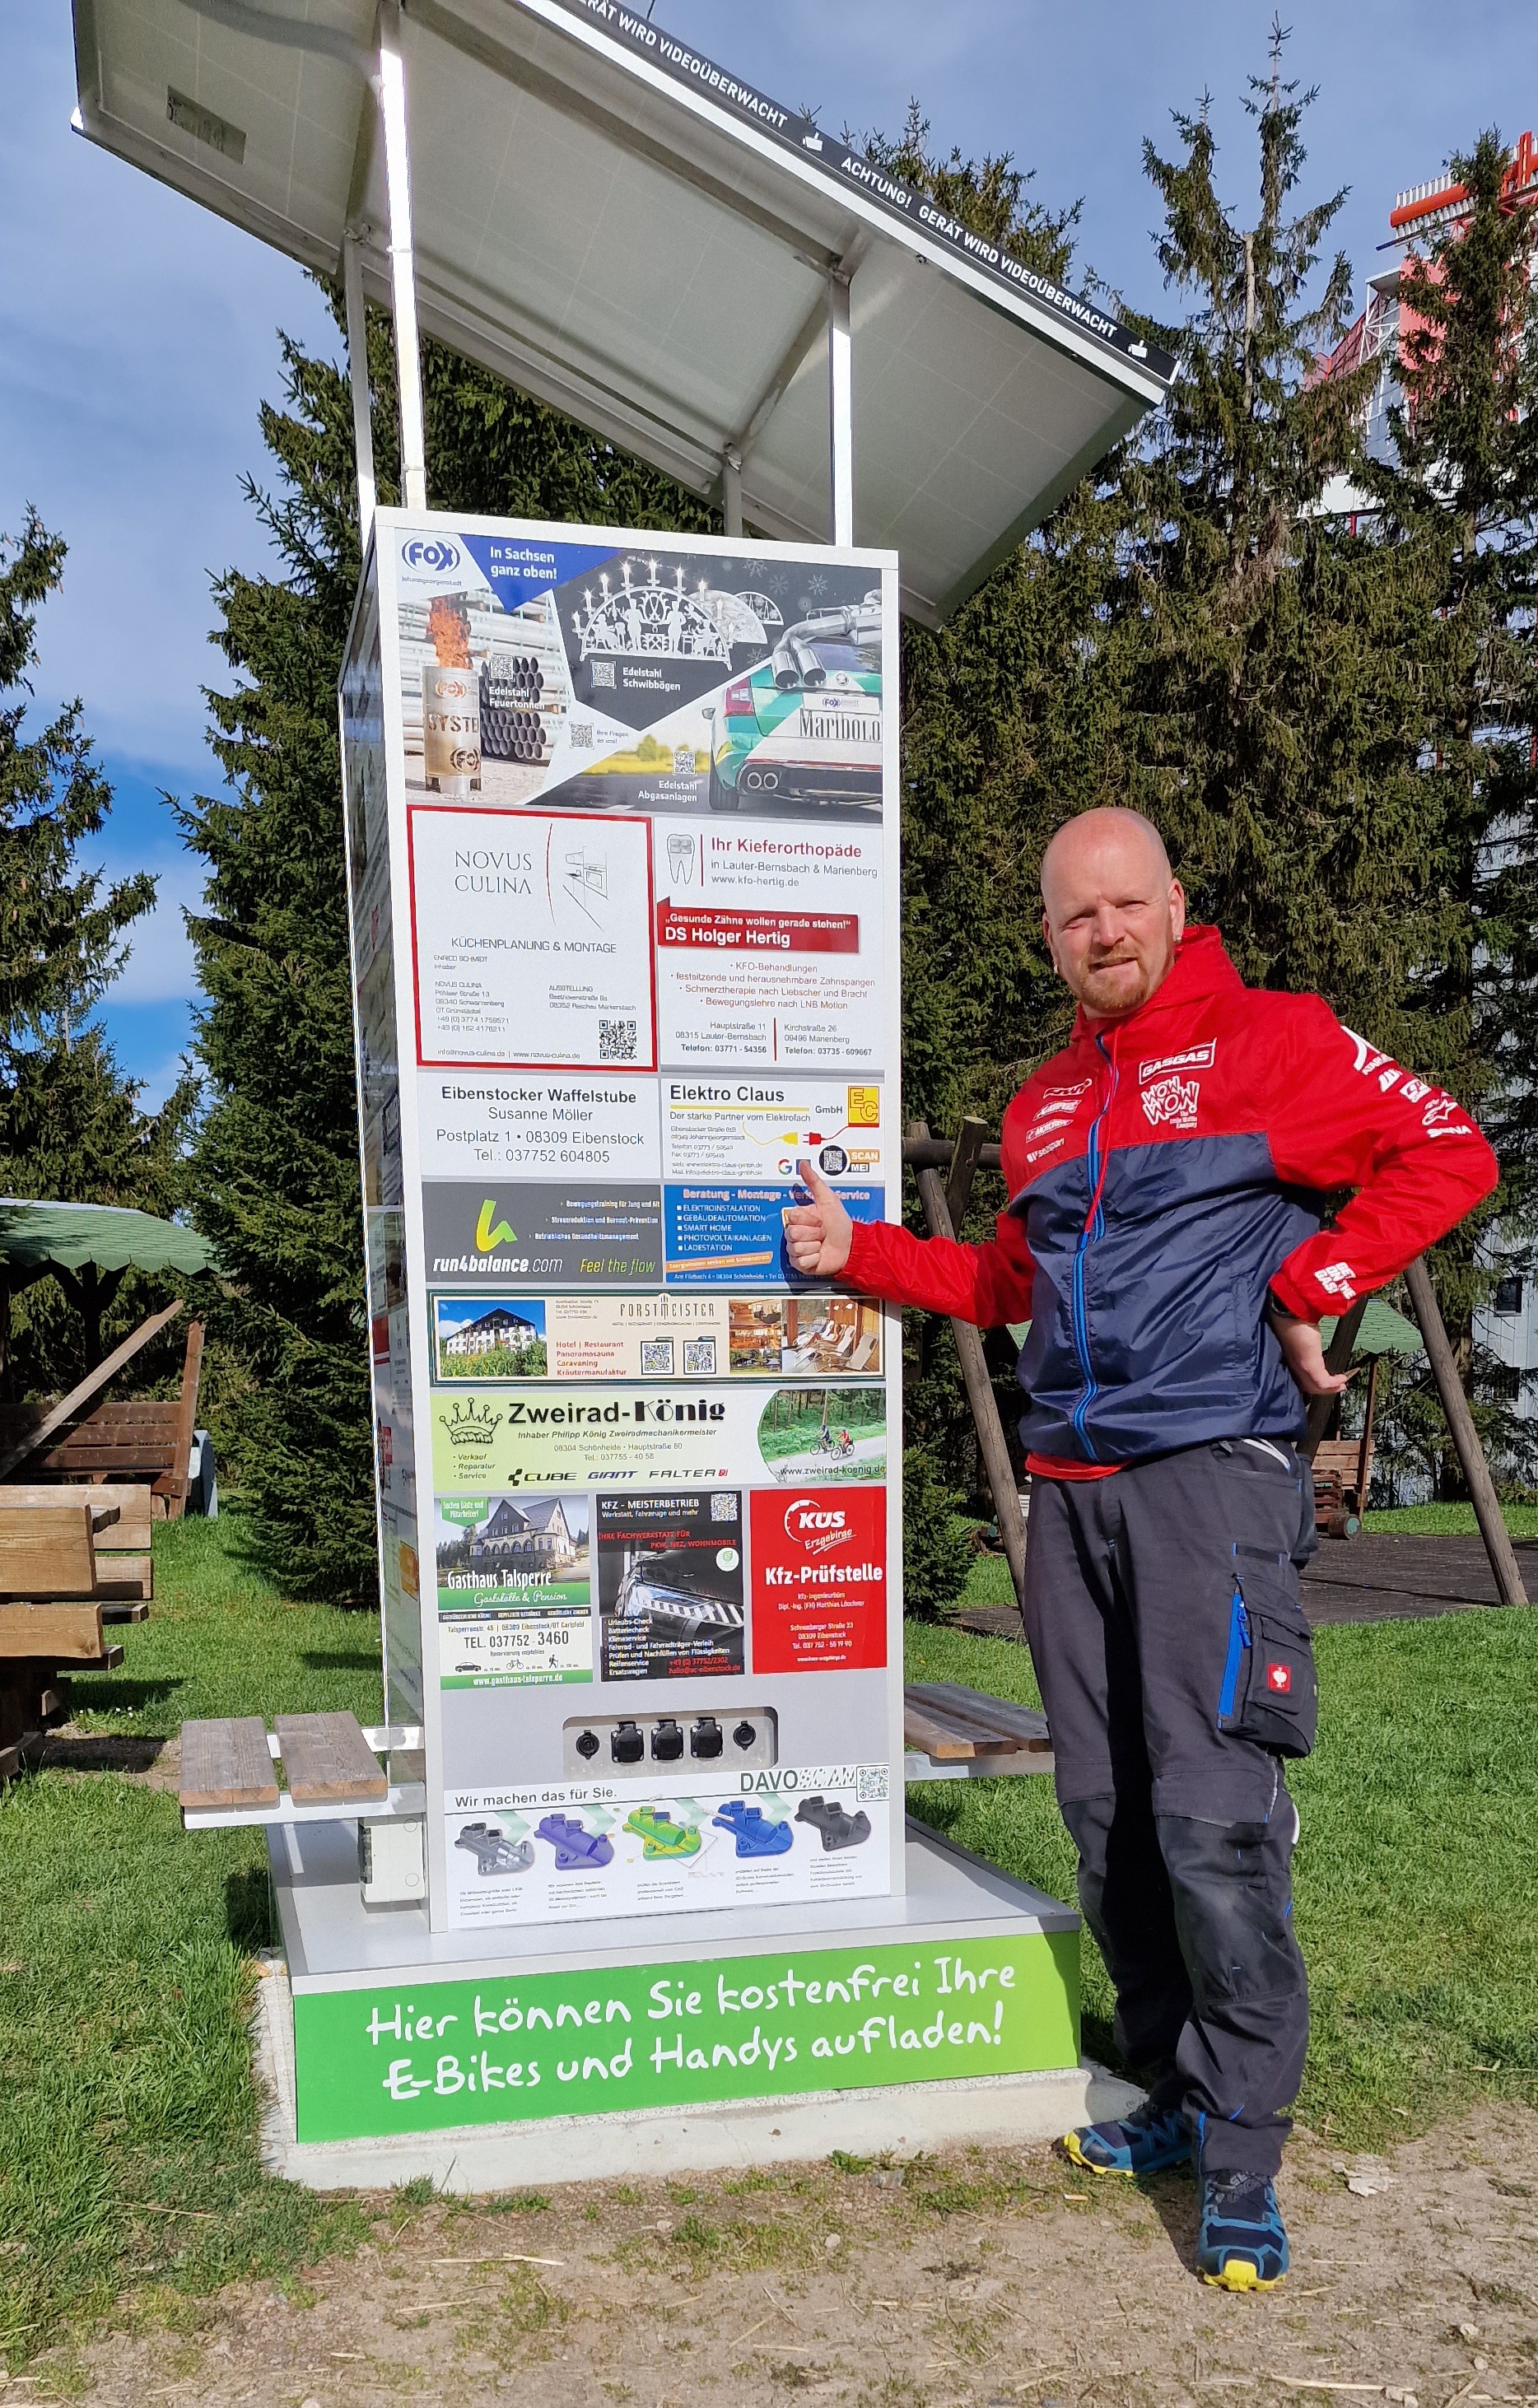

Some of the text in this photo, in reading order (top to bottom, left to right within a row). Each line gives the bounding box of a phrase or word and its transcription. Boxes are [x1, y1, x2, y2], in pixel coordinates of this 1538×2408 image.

[618, 12, 657, 46] WIRD
[659, 36, 788, 128] VIDEOÜBERWACHT
[841, 156, 1117, 339] ACHTUNG! GERÄT WIRD VIDEOÜBERWACHT
[409, 540, 454, 571] FOX
[490, 546, 555, 563] In Sachsen
[491, 566, 557, 580] ganz oben!
[622, 668, 662, 679] Edelstahl
[622, 678, 681, 691] Schwibbögen
[489, 687, 529, 698] Edelstahl
[489, 698, 545, 710] Feuertonnen
[659, 780, 698, 791] Edelstahl
[638, 791, 697, 803] Abgasanlagen
[711, 837, 862, 859] Ihr Kieferorthopäde
[454, 850, 532, 871] NOVUS
[711, 859, 878, 879] in Lauter-Bernsbach & Marienberg
[454, 875, 532, 895] CULINA
[711, 875, 799, 887] www.kfo-hertig.de
[715, 914, 743, 925] Zähne
[745, 917, 776, 927] wollen
[778, 919, 809, 930] gerade
[665, 927, 790, 948] DS Holger Hertig
[451, 936, 617, 953] KÜCHENPLANUNG & MONTAGE
[735, 962, 818, 973] KFO-Behandlungen
[729, 974, 745, 983] und
[748, 975, 818, 985] herausnehmbare
[819, 977, 875, 987] Zahnspangen
[685, 985, 757, 996] Schmerztherapie
[758, 987, 779, 995] nach
[781, 988, 822, 997] Liebscher
[823, 989, 839, 997] und
[706, 997, 776, 1008] Bewegungslehre
[778, 999, 798, 1008] nach
[821, 1001, 848, 1010] Motion
[758, 1022, 766, 1031] 11
[681, 1044, 738, 1053] Telefon: 03771
[785, 1047, 815, 1055] Telefon:
[1142, 1050, 1210, 1078] GASGAS
[441, 1086, 636, 1104] Eibenstocker Waffelstube
[670, 1085, 785, 1102] Elektro Claus
[488, 1106, 593, 1121] Susanne Möller
[670, 1111, 685, 1120] Der
[687, 1112, 711, 1120] starke
[714, 1113, 744, 1121] Partner
[766, 1113, 811, 1122] Elektrofach
[815, 1106, 843, 1114] GmbH
[436, 1129, 645, 1145] Postplatz 1 08309 Eibenstock
[473, 1148, 610, 1162] Tel.: 037752 604805
[851, 1153, 879, 1161] SCAN
[851, 1163, 869, 1172] ME!
[683, 1189, 730, 1201] Beratung
[737, 1190, 781, 1201] Montage
[683, 1204, 761, 1213] ELEKTROINSTALATION
[683, 1213, 766, 1223] GEBÄUDEAUTOMATION
[683, 1224, 733, 1232] SMART HOME
[683, 1244, 733, 1252] LADESTATION
[433, 1255, 563, 1273] run4balance.com
[580, 1259, 604, 1273] Feel
[608, 1259, 627, 1273] the
[629, 1260, 655, 1275] flow
[620, 1303, 715, 1319] FORSTMEISTER
[557, 1359, 599, 1367] Caravaning
[557, 1368, 627, 1376] Kräutermanufaktur
[508, 1399, 725, 1423] Zweirad-König
[518, 1428, 717, 1440] Inhaber Philipp König Zweiradmechanikermeister
[579, 1443, 621, 1451] Schönheide
[458, 1453, 487, 1461] Verkauf
[600, 1453, 627, 1461] 037755
[459, 1462, 496, 1470] Reparatur
[781, 1465, 886, 1475] www.zweirad-koenig.de
[524, 1469, 716, 1482] CUBE GIANT FALTER
[602, 1498, 700, 1510] KFZ MEISTERBETRIEB
[799, 1511, 846, 1529] KÜS
[804, 1529, 853, 1550] Erzgebirge
[448, 1568, 552, 1591] Gasthaus Talsperre
[766, 1563, 883, 1585] Kfz-Prüfstelle
[521, 1593, 529, 1603] &
[533, 1591, 567, 1603] Pension
[464, 1630, 569, 1649] TEL. 037752 3460
[741, 1767, 855, 1791] DAVOSCAN
[454, 1787, 618, 1807] Wir machen das für Sie.
[366, 1956, 1015, 2045] Hier können Sie kostenfrei Ihre
[383, 2000, 1004, 2100] E-Bikes und Handys aufladen!
